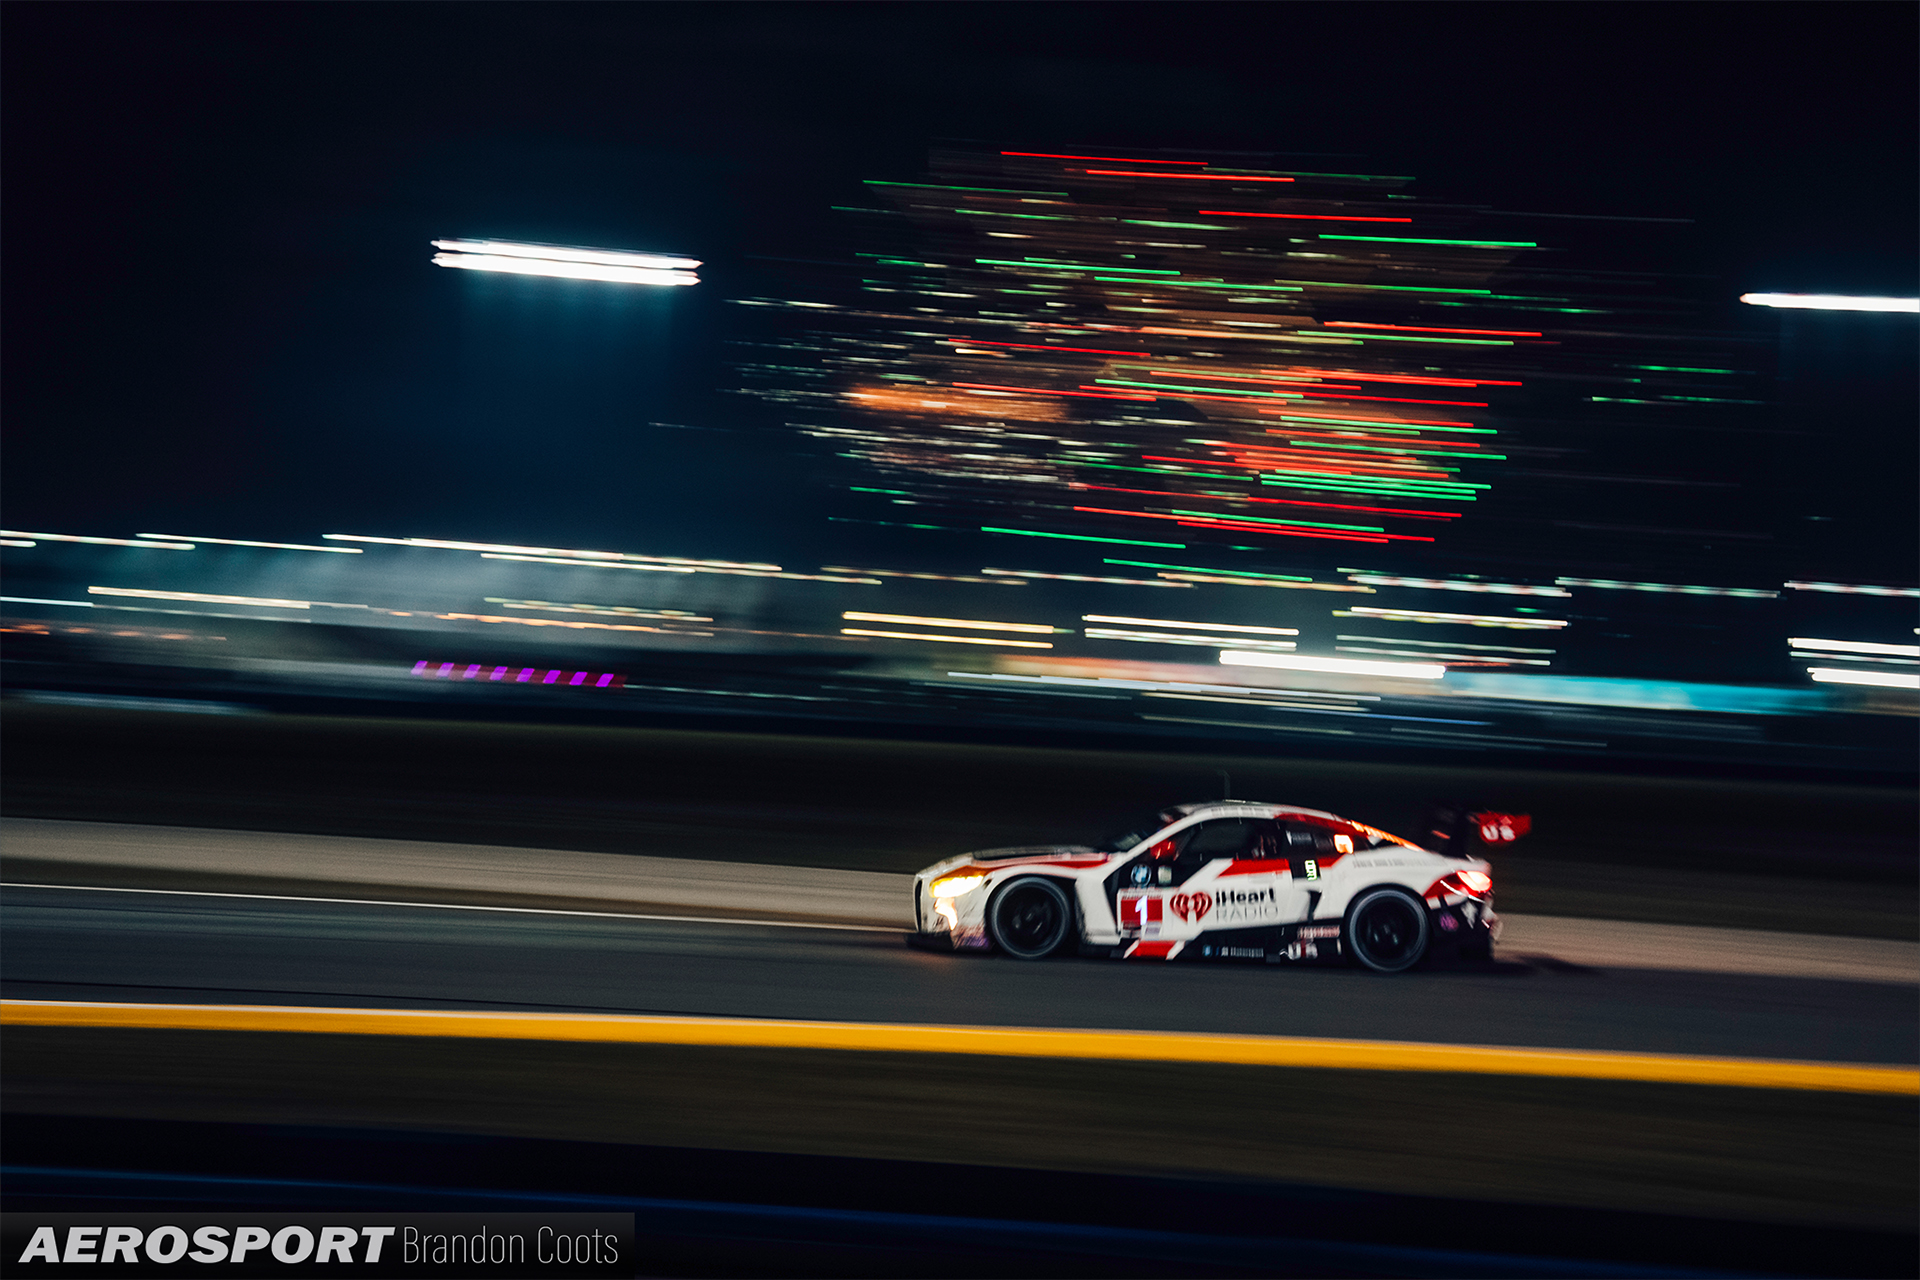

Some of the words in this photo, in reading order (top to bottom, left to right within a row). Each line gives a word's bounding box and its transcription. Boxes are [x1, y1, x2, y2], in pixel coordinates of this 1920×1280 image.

[1216, 888, 1276, 905] iHeart
[1135, 895, 1149, 926] 1
[1216, 906, 1279, 921] RADIO
